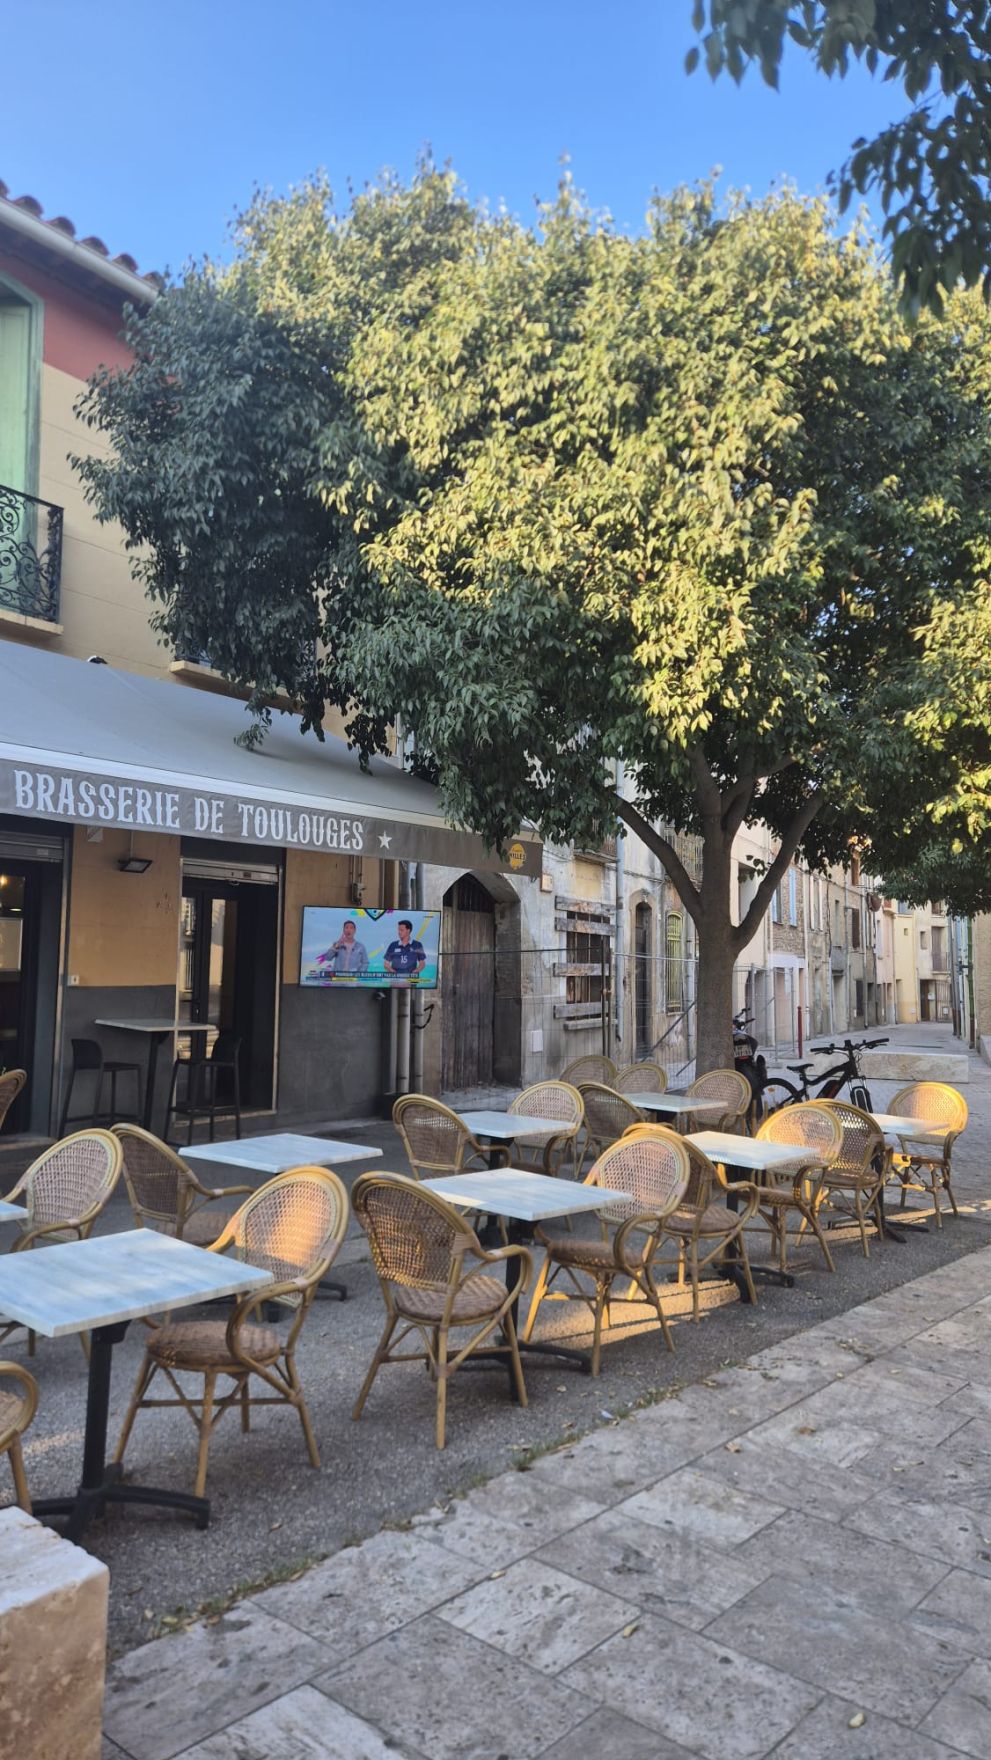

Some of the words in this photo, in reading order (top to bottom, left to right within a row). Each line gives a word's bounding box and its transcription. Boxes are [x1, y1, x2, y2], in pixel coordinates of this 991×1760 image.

[13, 769, 181, 829] BRASSERIE
[194, 797, 225, 834] DE
[238, 803, 364, 850] TOULOUGES
[400, 955, 408, 964] 15
